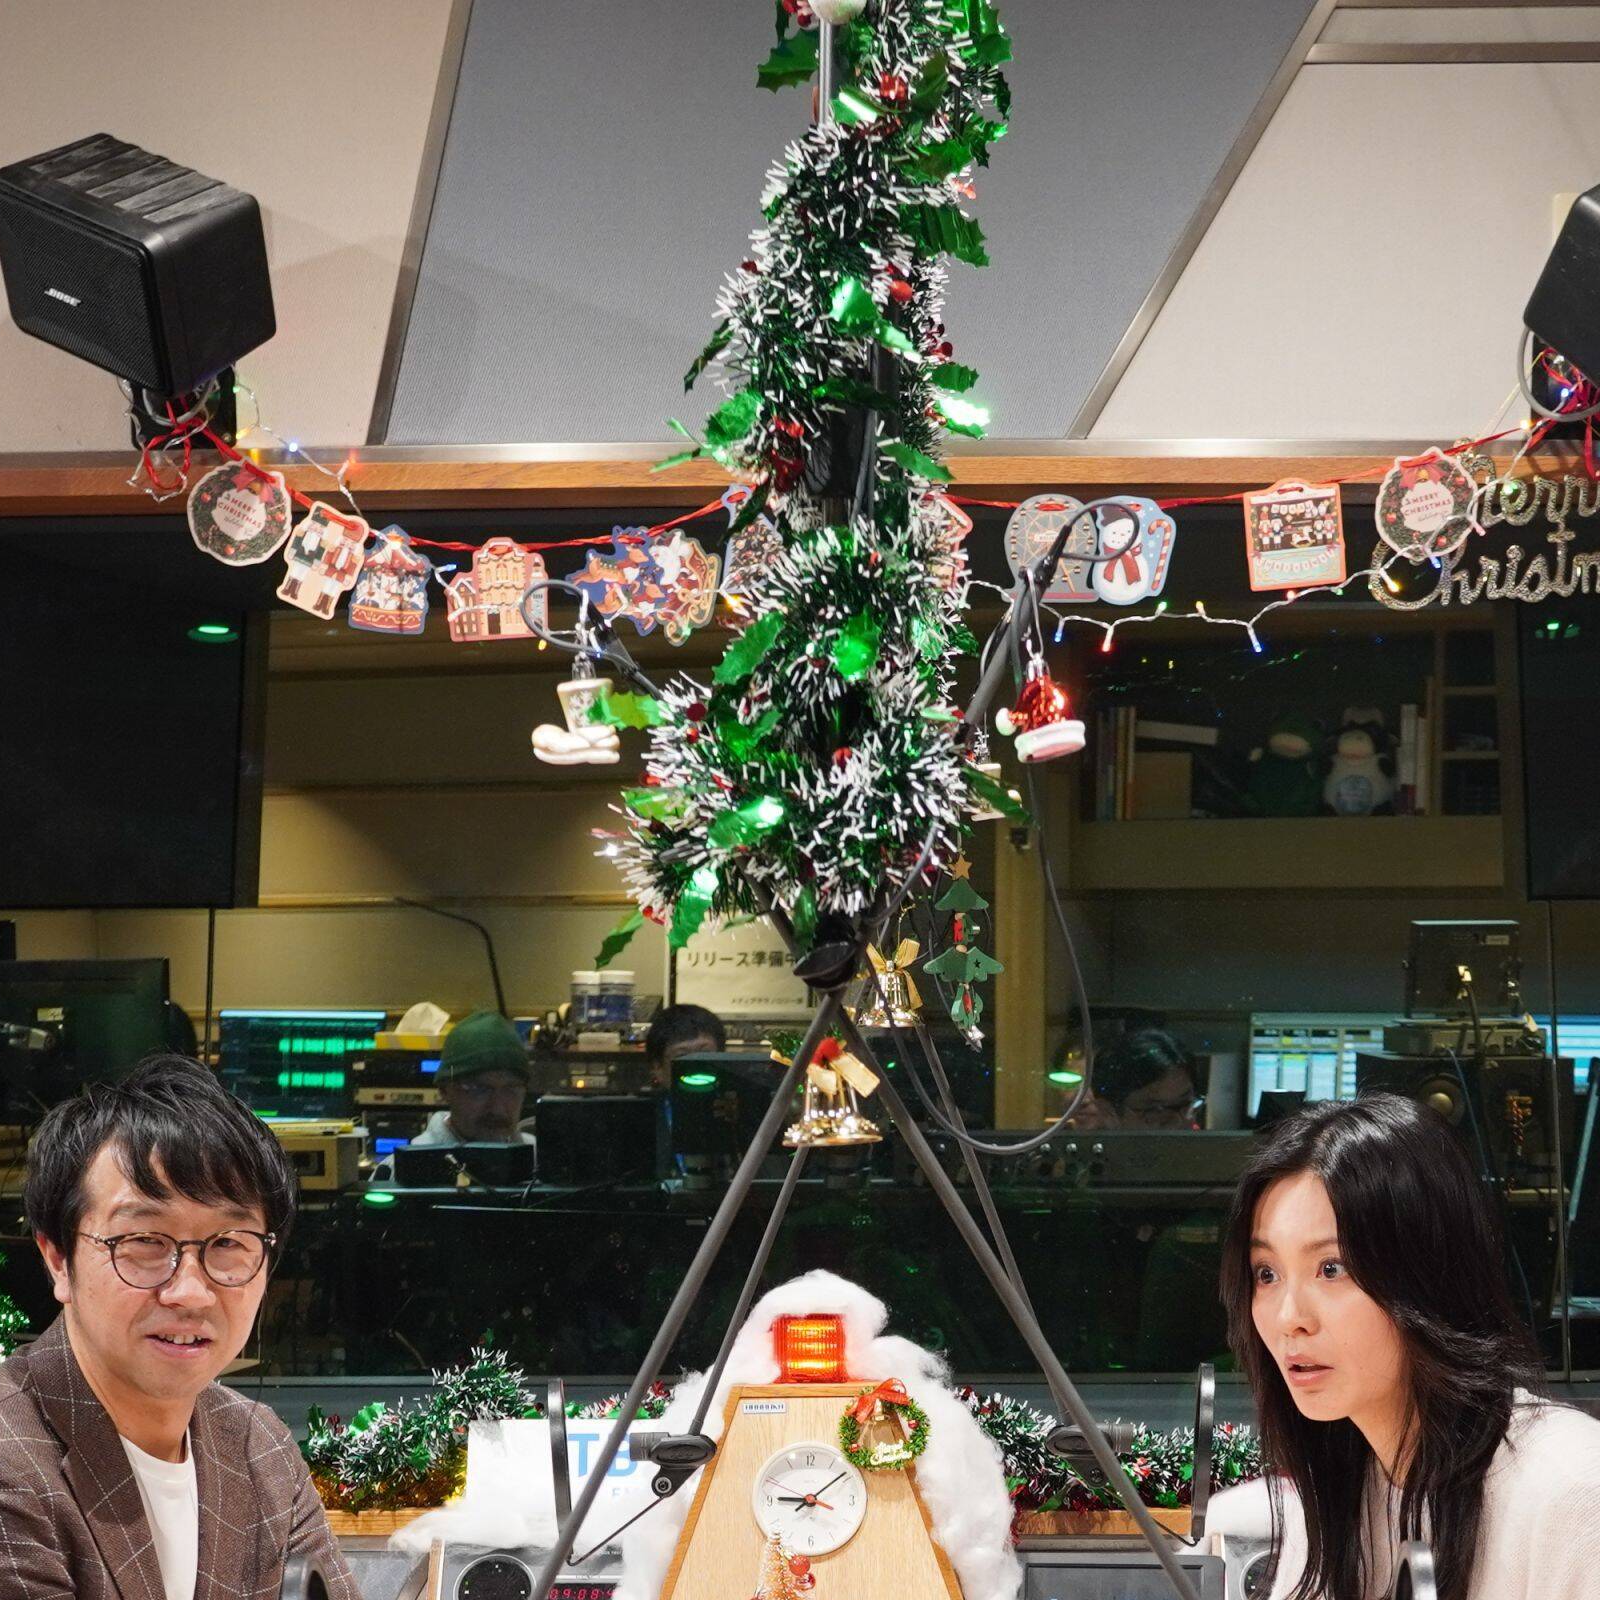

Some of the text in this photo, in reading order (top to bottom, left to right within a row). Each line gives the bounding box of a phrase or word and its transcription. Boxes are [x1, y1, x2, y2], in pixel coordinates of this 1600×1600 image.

[806, 1454, 816, 1467] 12
[766, 1494, 774, 1508] 9
[848, 1494, 856, 1507] 3
[807, 1535, 815, 1548] 6
